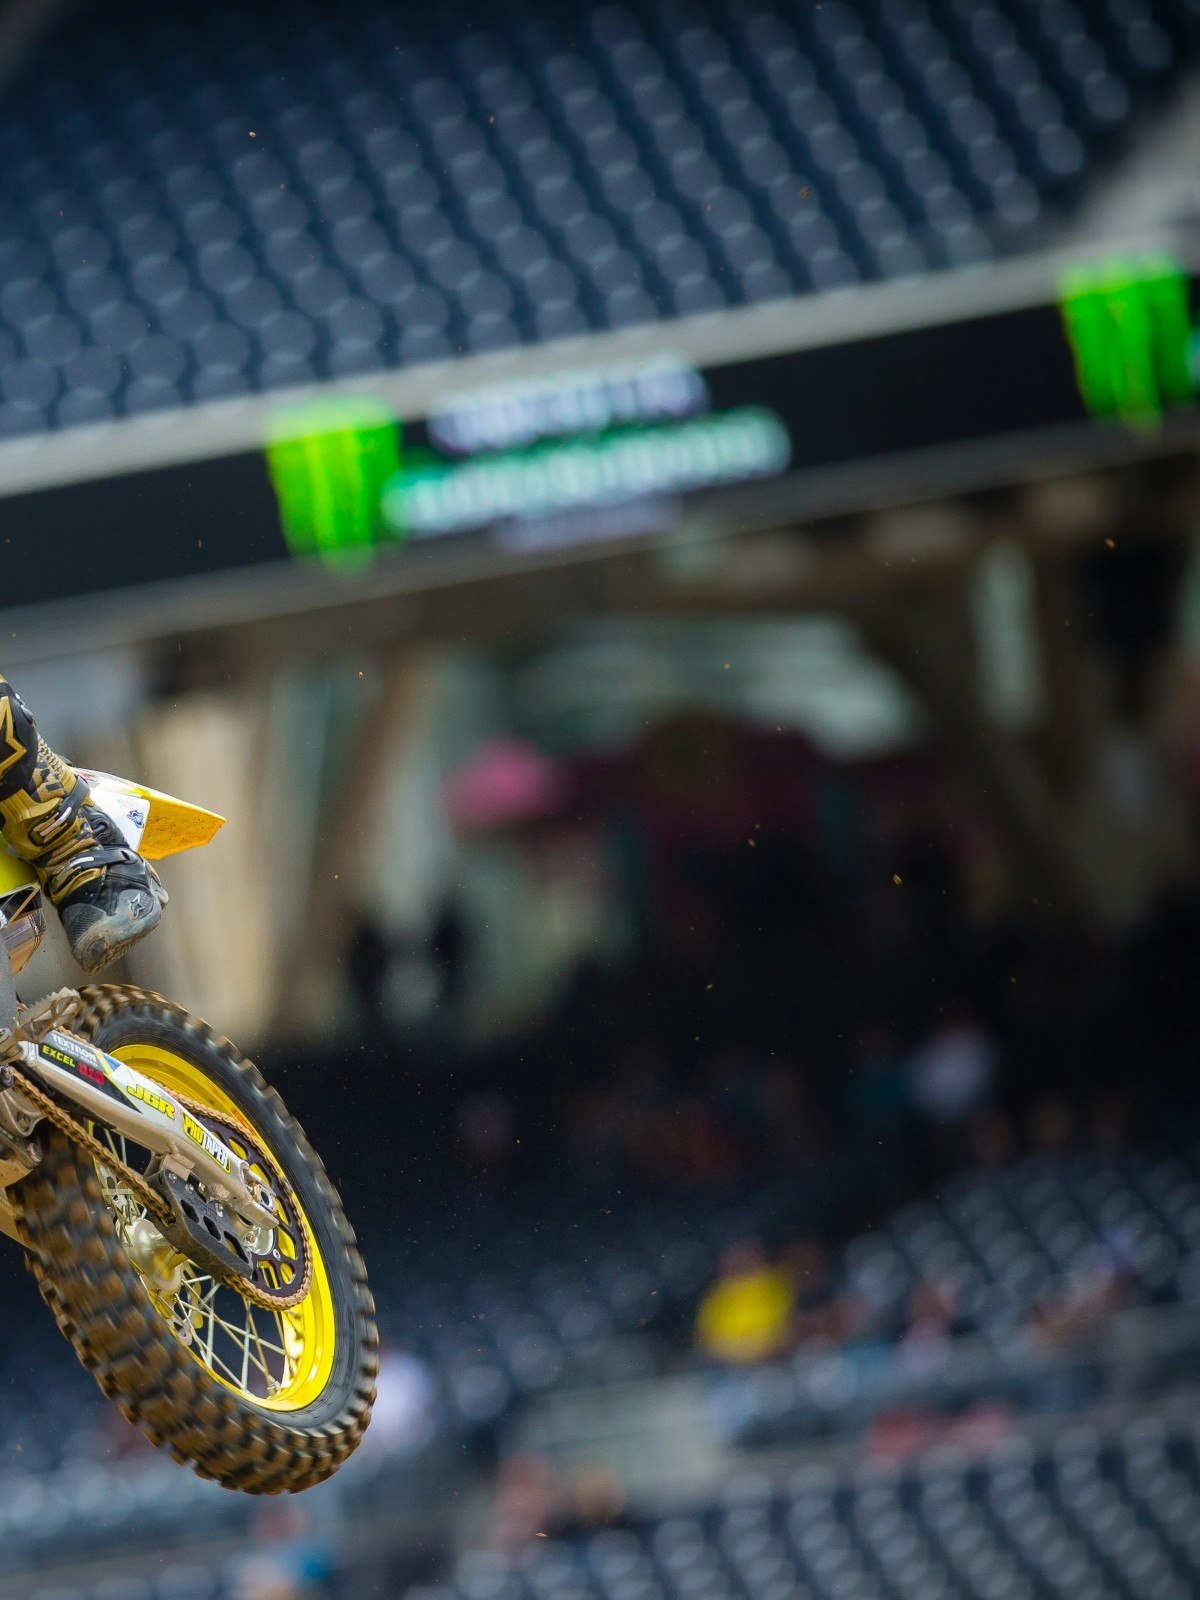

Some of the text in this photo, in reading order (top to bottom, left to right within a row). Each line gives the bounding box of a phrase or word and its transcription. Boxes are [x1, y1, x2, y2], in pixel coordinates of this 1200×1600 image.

[42, 1045, 76, 1068] EXCEL
[51, 1032, 98, 1063] TEXTRON
[127, 1083, 176, 1120] JGR
